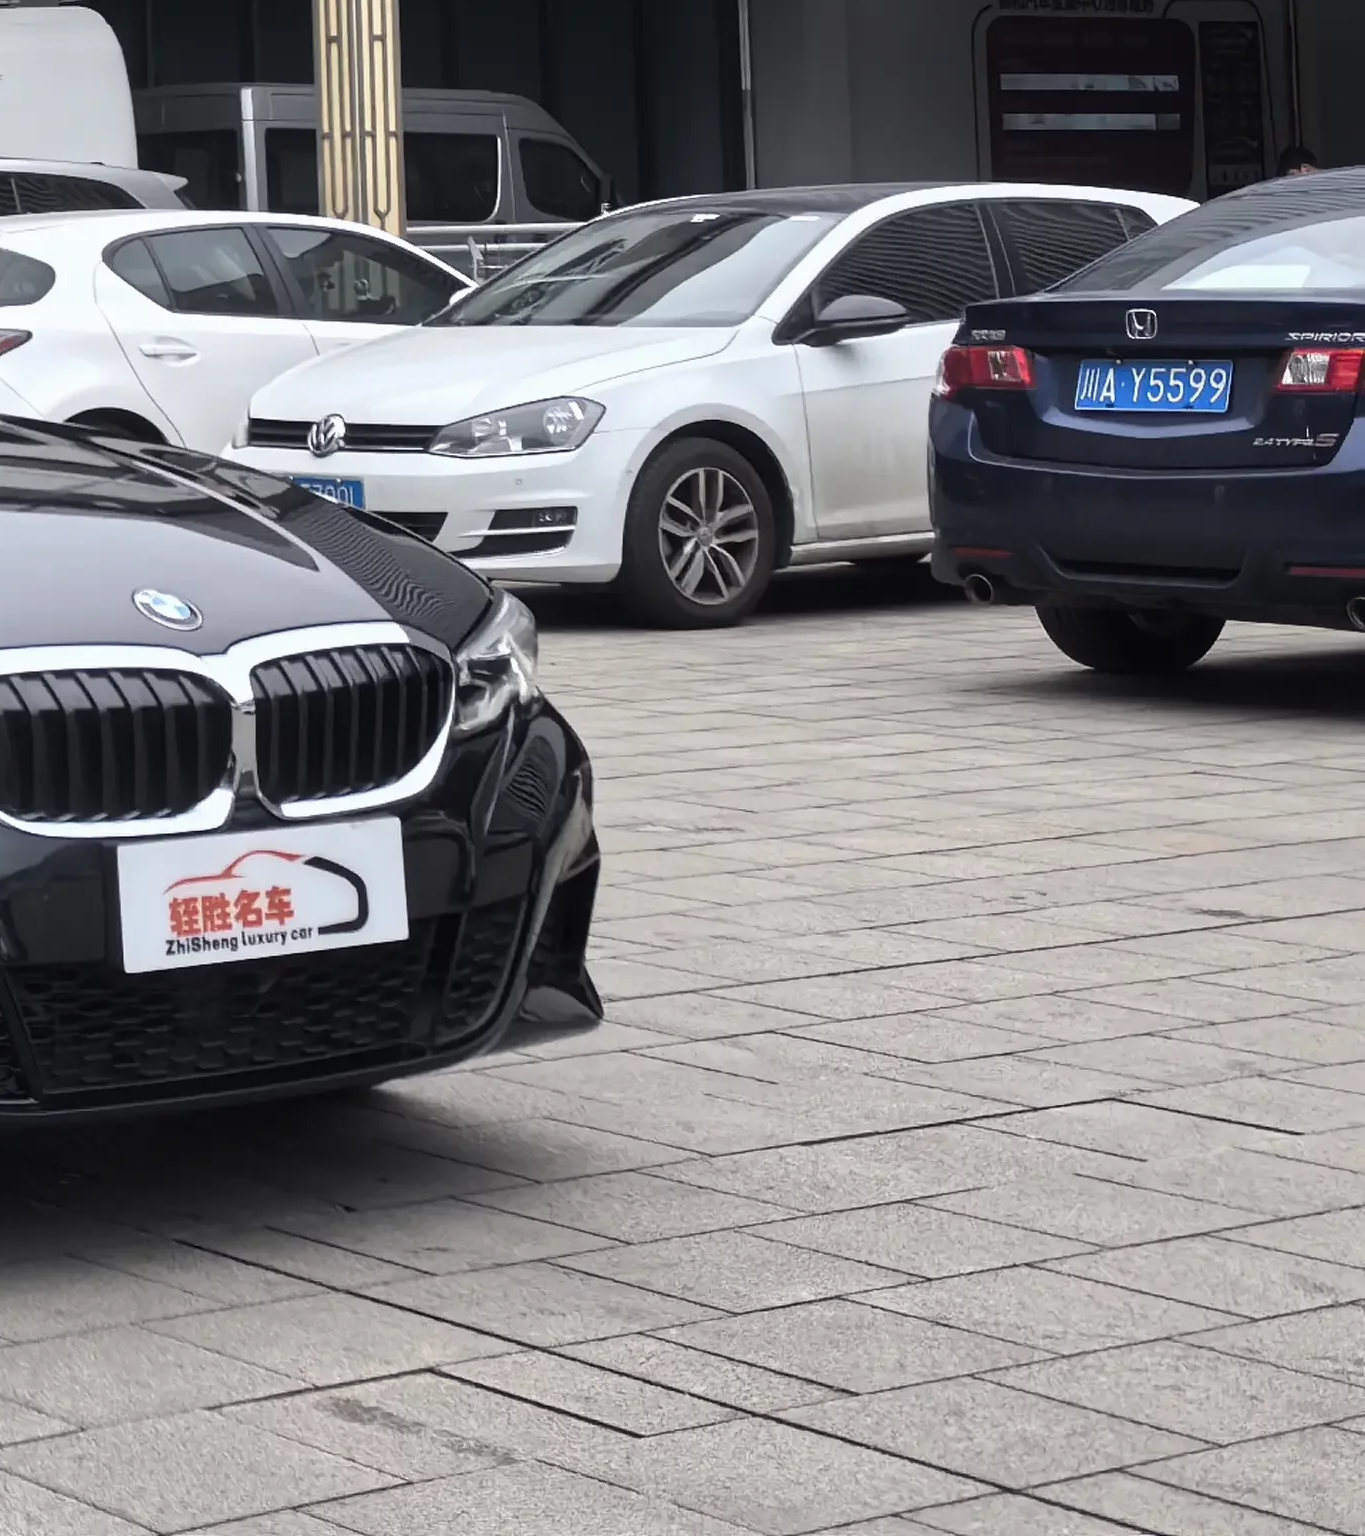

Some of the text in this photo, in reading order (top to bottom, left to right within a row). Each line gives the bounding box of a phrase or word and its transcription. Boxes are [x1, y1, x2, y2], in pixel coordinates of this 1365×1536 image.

[165, 927, 314, 956] ZhiSheng luxury car
